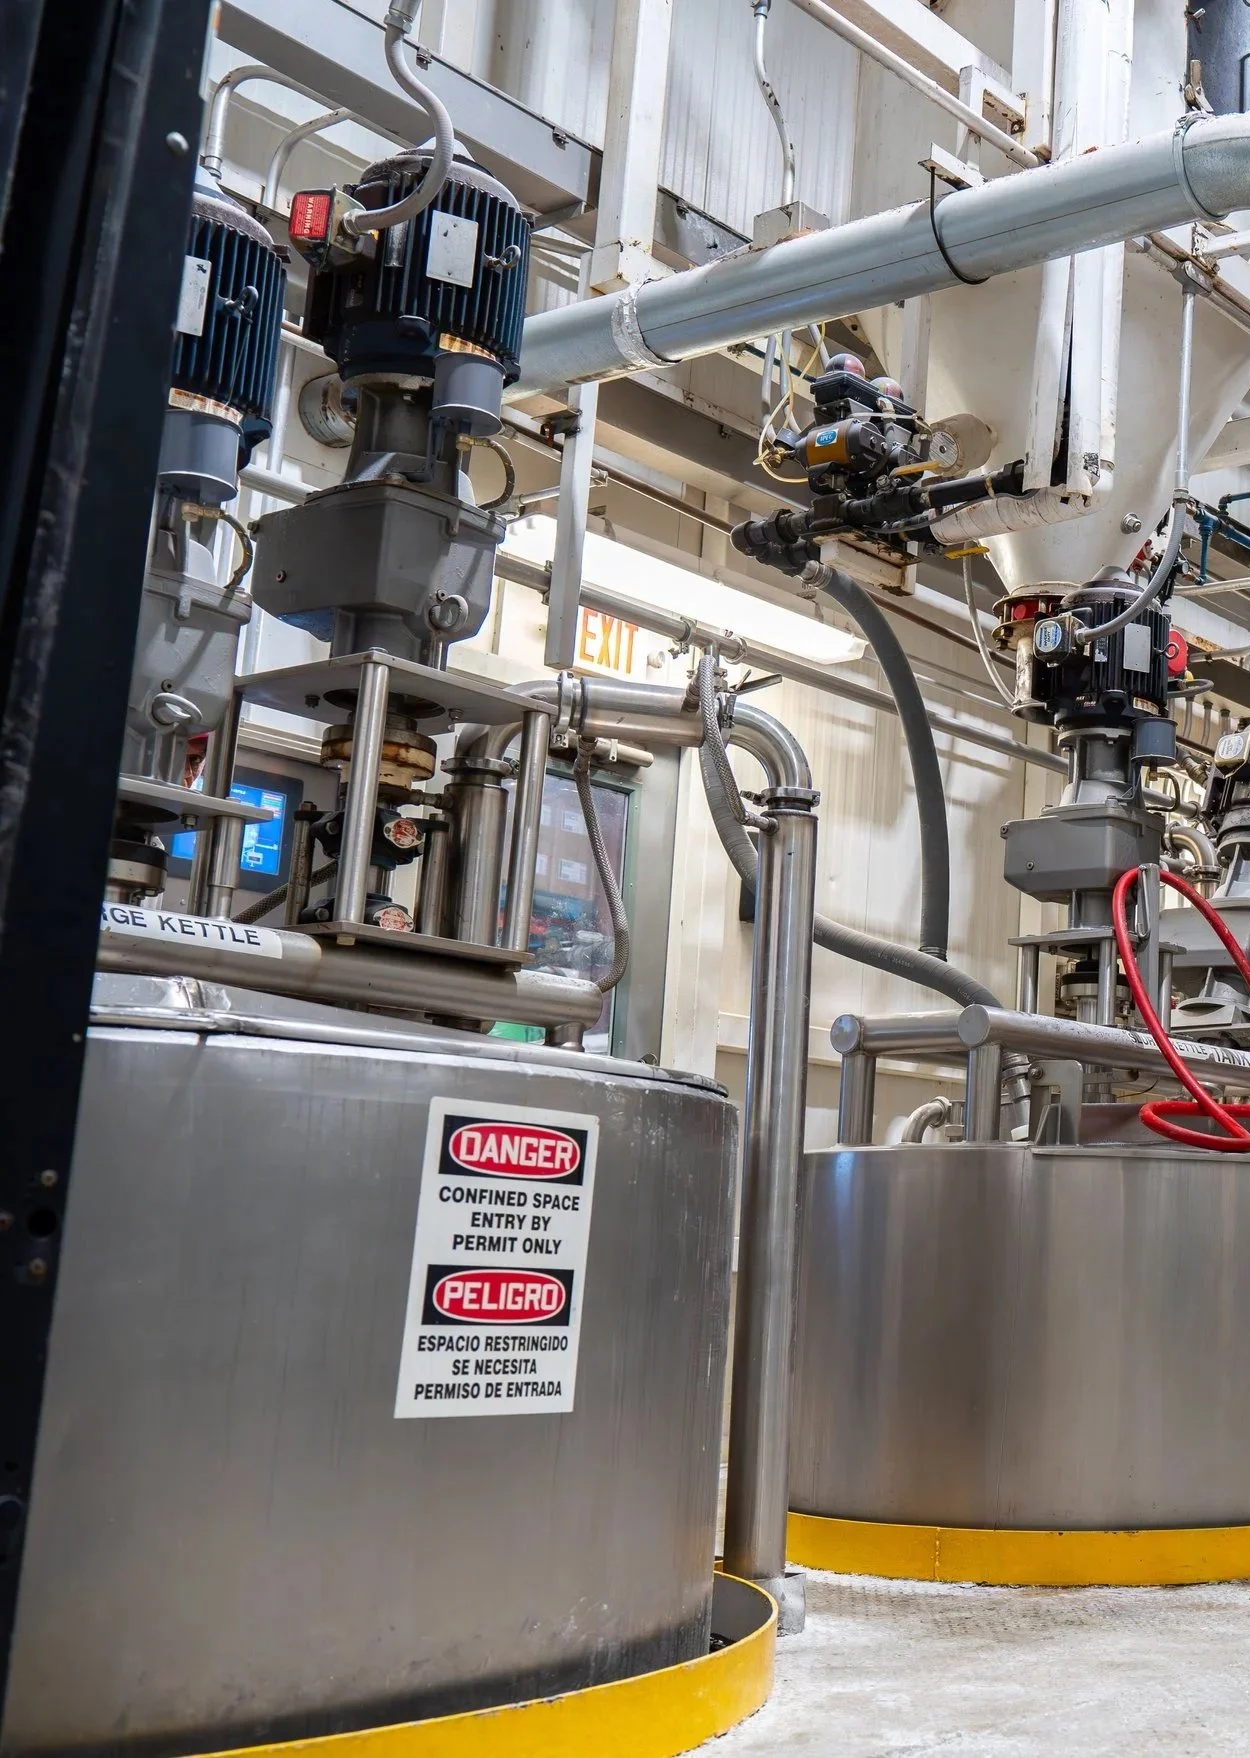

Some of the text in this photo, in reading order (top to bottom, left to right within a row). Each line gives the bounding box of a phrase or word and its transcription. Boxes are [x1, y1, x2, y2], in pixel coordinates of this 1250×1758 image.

[304, 197, 315, 234] WARNING
[580, 607, 638, 674] EXIT
[158, 915, 261, 946] KETTLE
[459, 1131, 574, 1170] DANGER
[439, 1186, 580, 1211] CONFINED SPACE
[471, 1212, 552, 1232] ENTRY BY
[452, 1234, 562, 1255] PERMIT ONLY
[443, 1280, 559, 1311] PELIGRO
[417, 1335, 569, 1352] ESPACIO RESTRINGIDO
[452, 1358, 537, 1376] SE NECESITA
[414, 1381, 562, 1400] PERMISO DE ENTRADA
